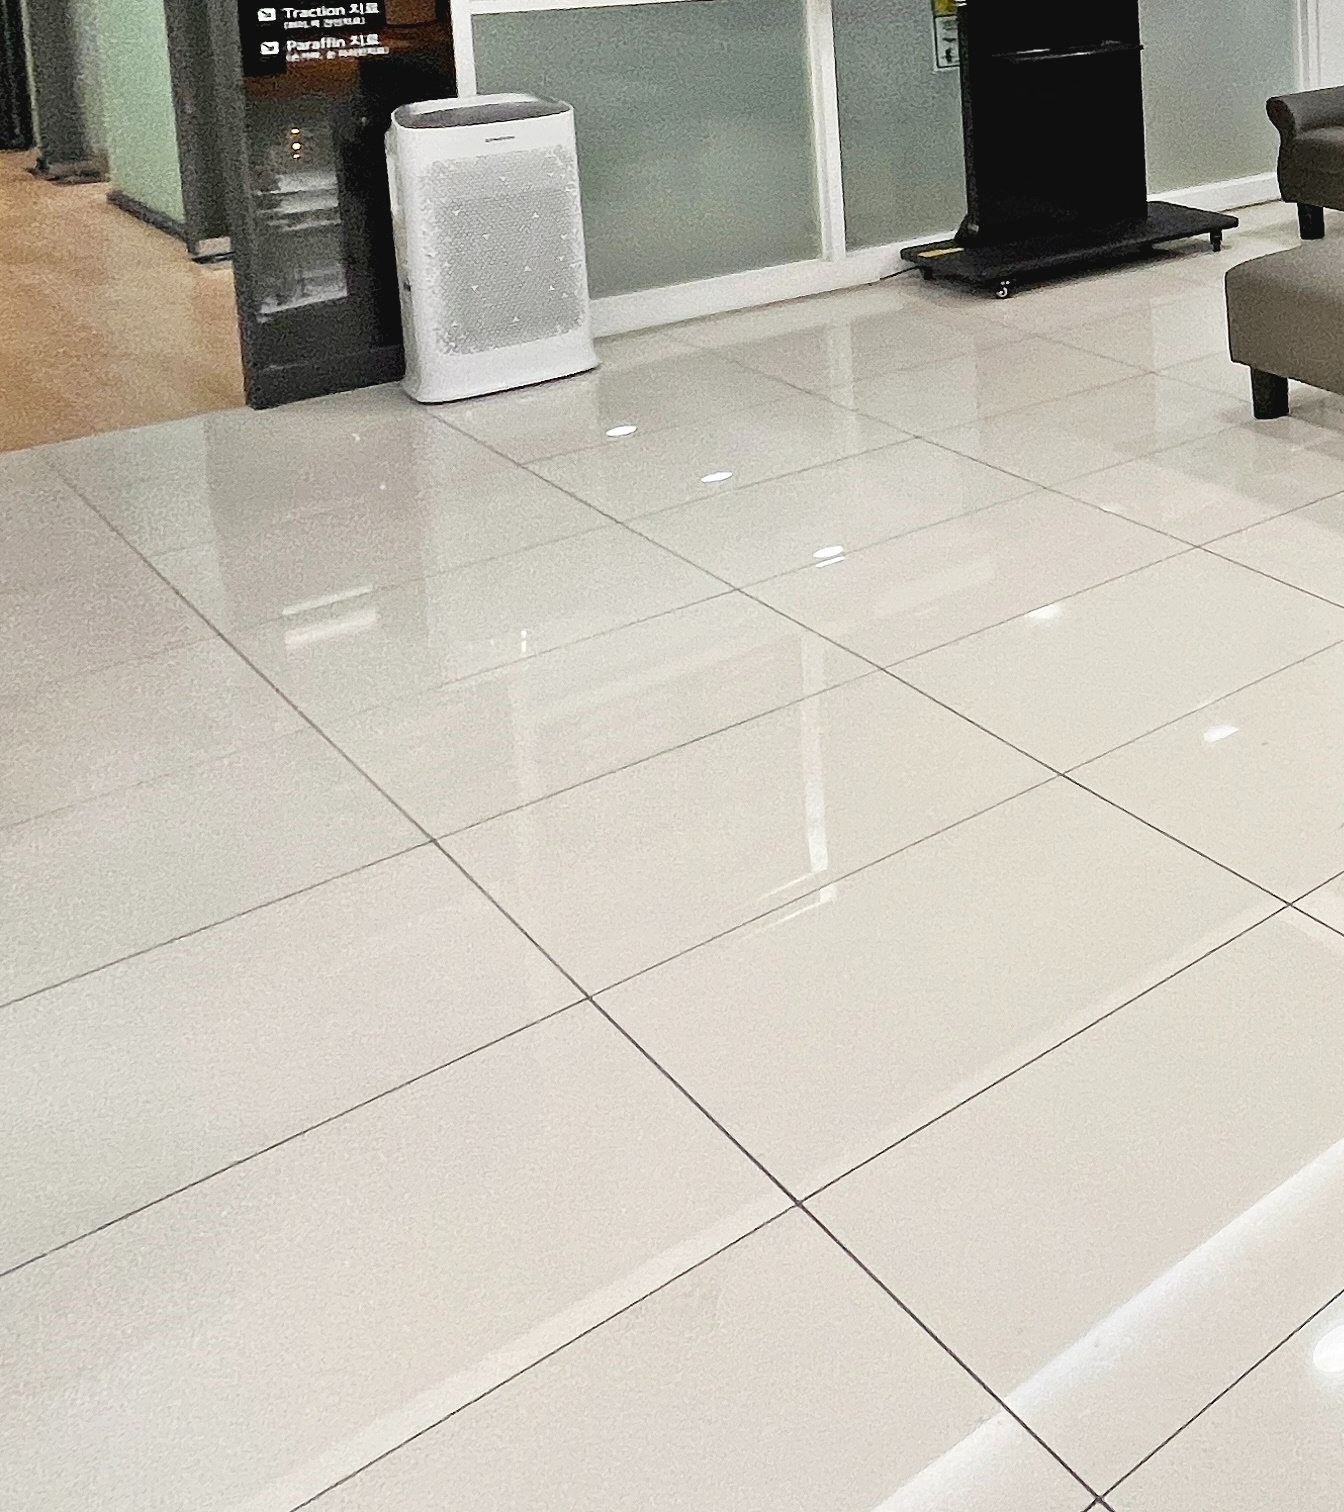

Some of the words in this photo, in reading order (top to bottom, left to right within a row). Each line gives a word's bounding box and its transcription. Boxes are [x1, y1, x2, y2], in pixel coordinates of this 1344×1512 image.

[282, 6, 345, 18] Traction
[350, 2, 379, 14] 치료
[286, 38, 345, 51] Paraffin
[350, 34, 379, 45] 치료
